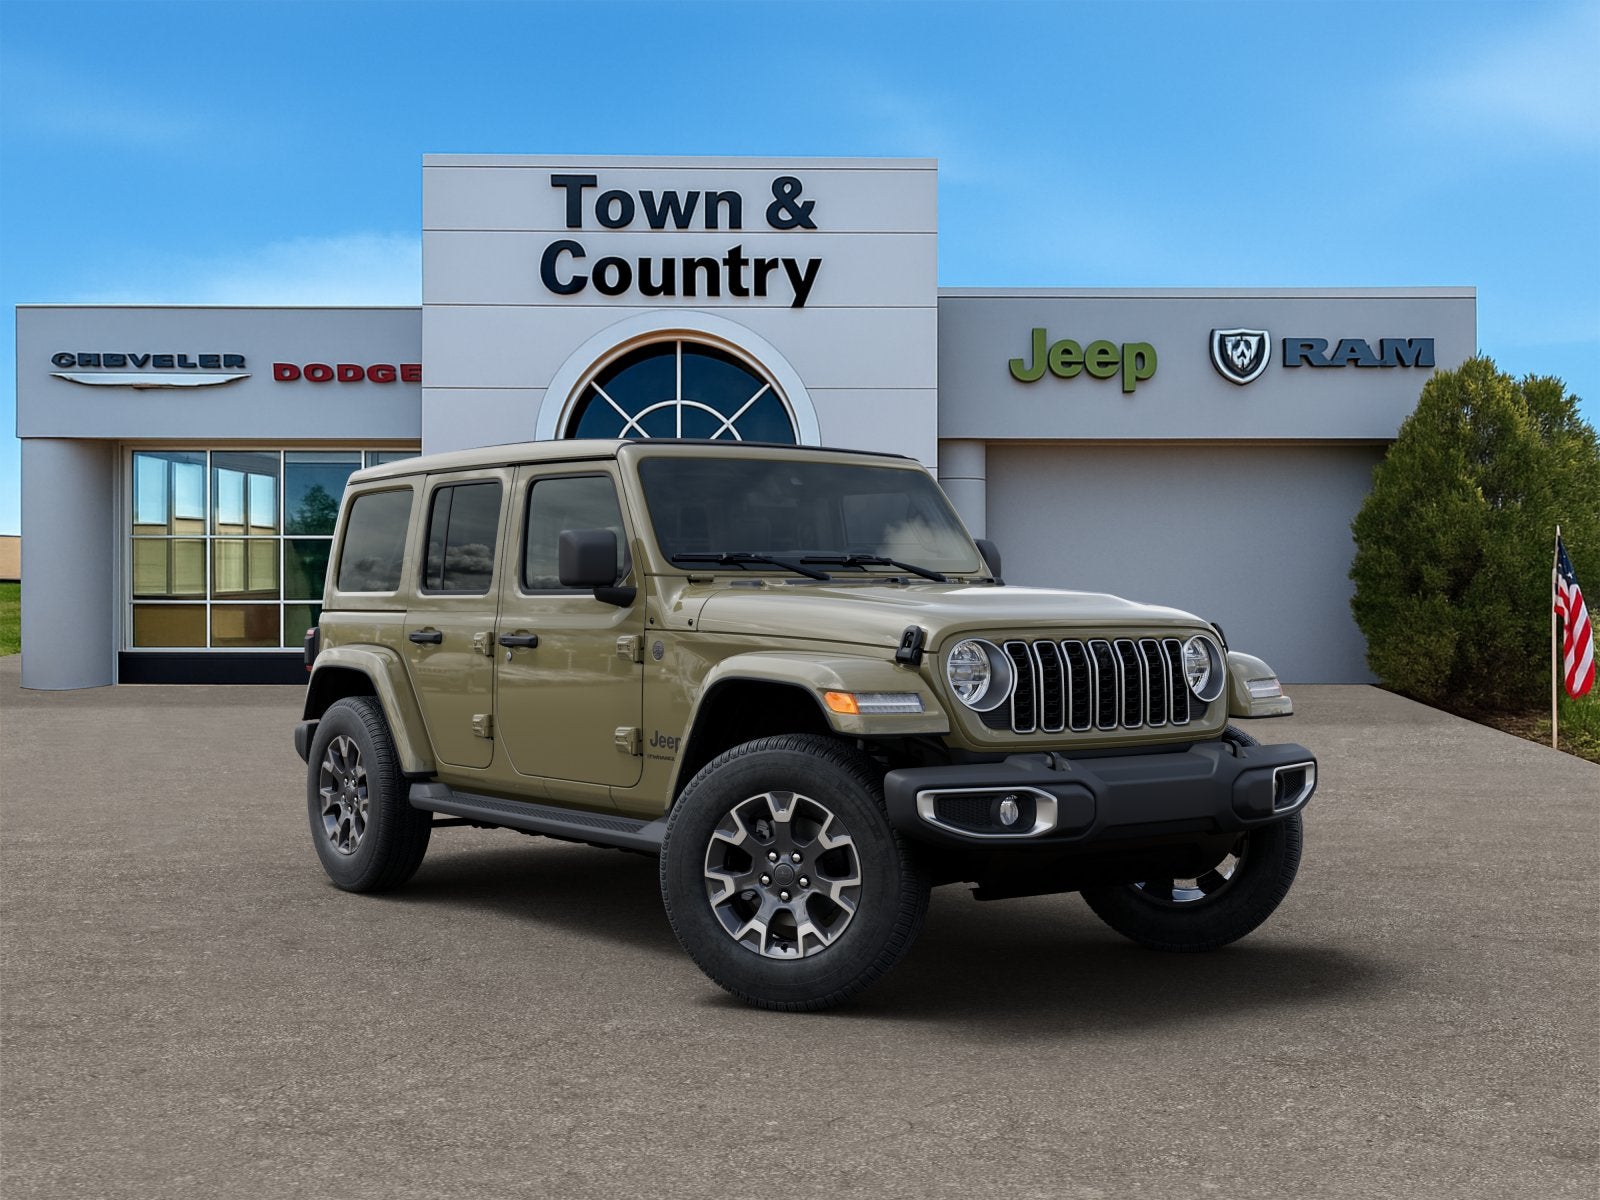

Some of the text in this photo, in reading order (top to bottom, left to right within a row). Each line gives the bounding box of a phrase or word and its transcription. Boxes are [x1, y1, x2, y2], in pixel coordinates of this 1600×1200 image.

[550, 174, 818, 230] Town &
[540, 239, 823, 309] Country
[273, 363, 421, 383] DODGE
[1009, 328, 1158, 392] Jeep
[1282, 337, 1436, 368] RAM
